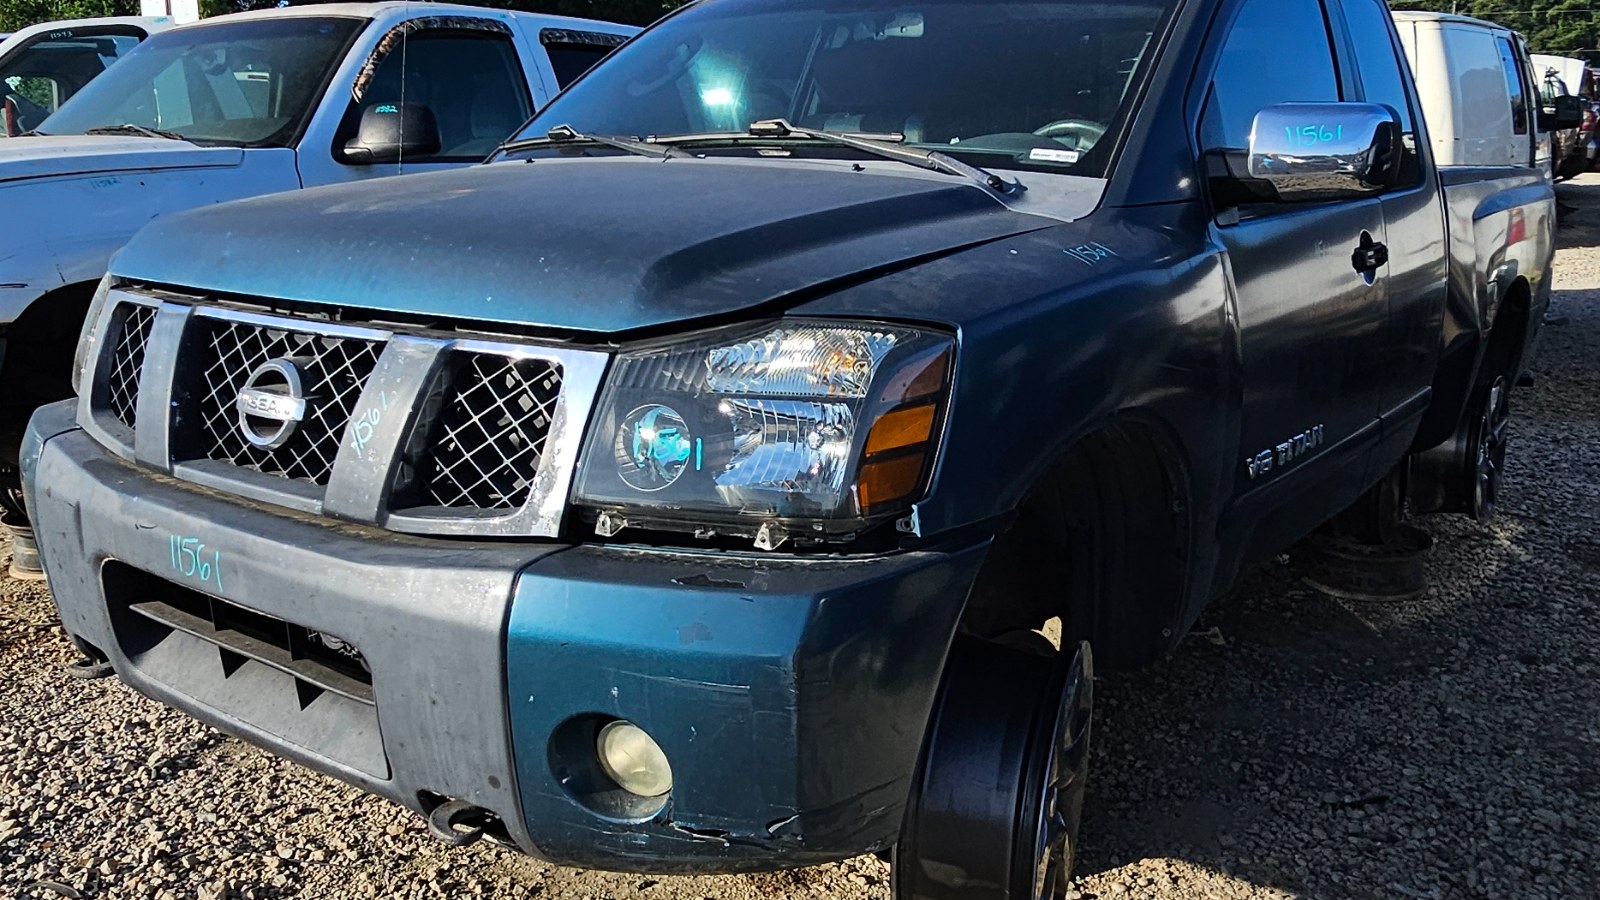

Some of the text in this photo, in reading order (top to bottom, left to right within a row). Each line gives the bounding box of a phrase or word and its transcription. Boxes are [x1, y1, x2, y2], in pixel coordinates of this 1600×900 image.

[1285, 124, 1342, 149] 11561
[1062, 241, 1119, 266] 11561
[1276, 424, 1324, 466] TITAN
[170, 535, 223, 593] 11561
